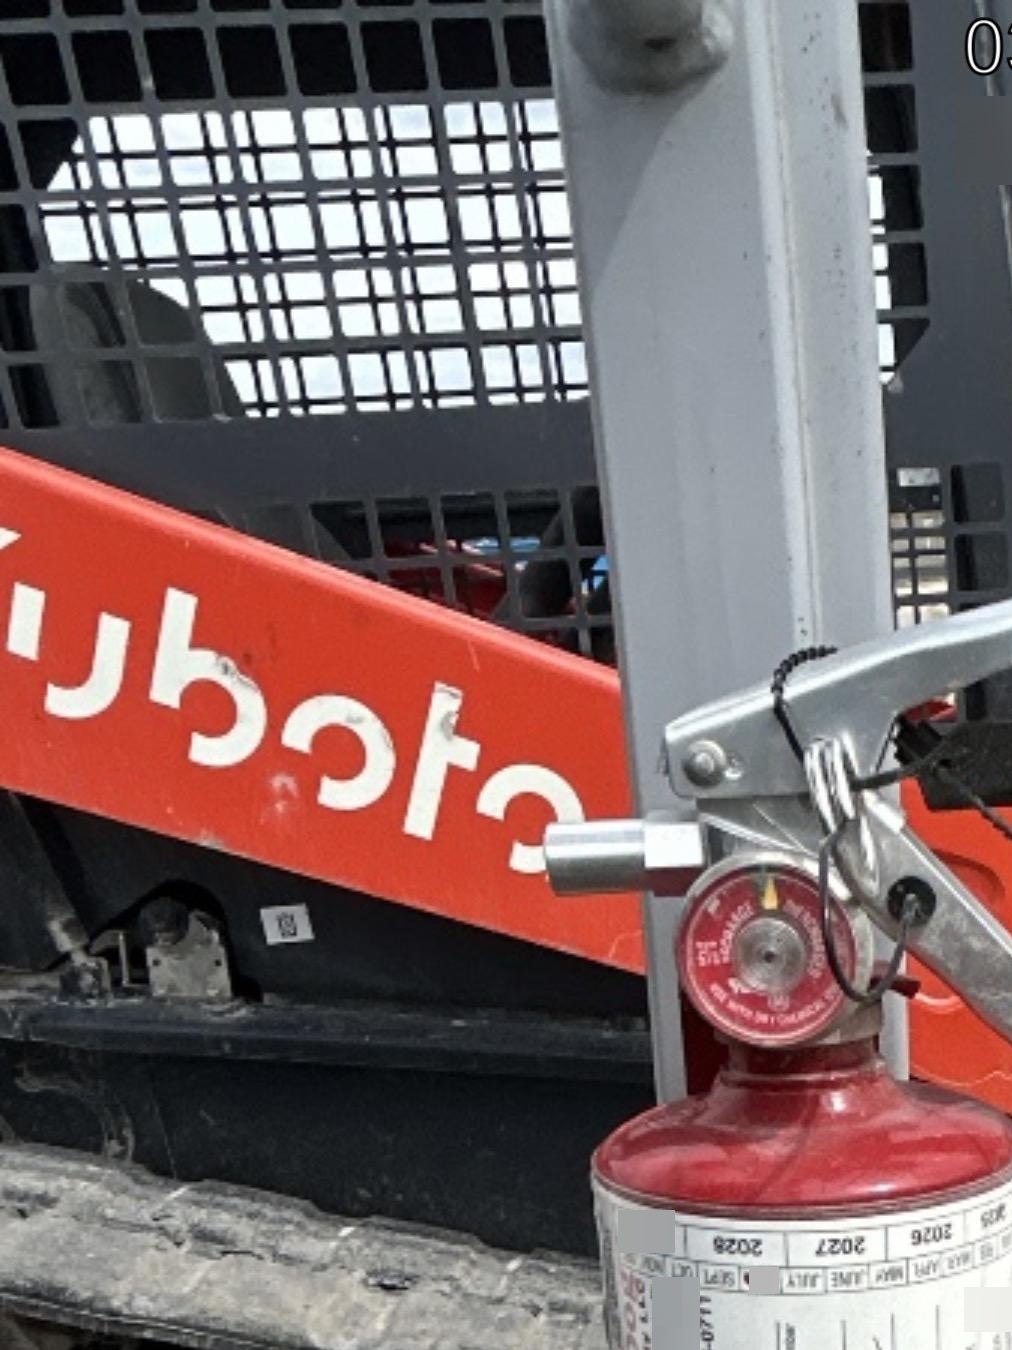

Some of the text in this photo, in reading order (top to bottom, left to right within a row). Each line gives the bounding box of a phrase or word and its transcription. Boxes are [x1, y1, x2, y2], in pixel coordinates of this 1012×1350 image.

[0, 526, 585, 874] ubota
[911, 1224, 952, 1246] 2026
[714, 1236, 763, 1257] 2028
[816, 1236, 865, 1257] 2027
[704, 1264, 736, 1286] SEPT
[788, 1273, 821, 1288] JULY
